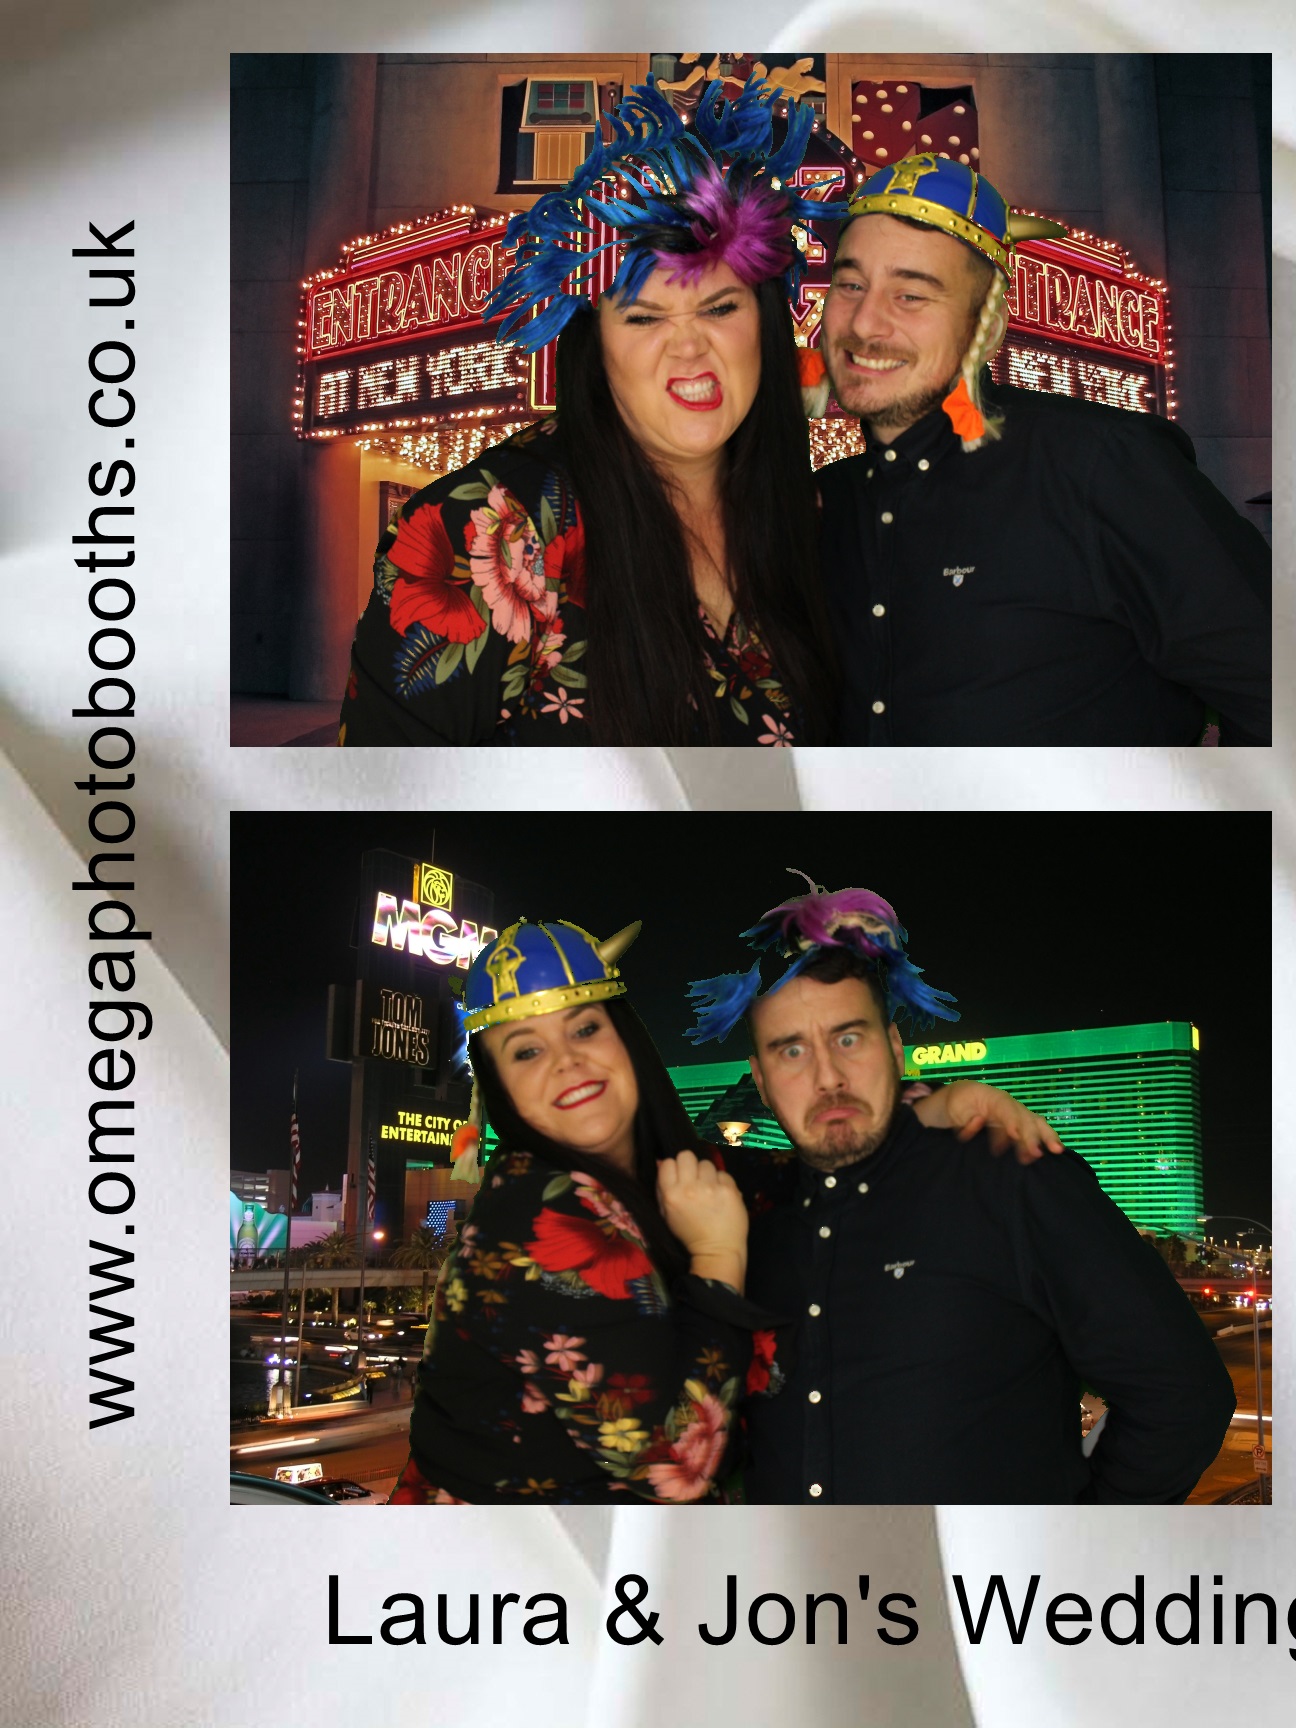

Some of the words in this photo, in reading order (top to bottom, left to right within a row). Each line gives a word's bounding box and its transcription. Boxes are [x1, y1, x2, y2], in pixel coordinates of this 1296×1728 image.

[312, 239, 522, 350] ENTRANCE
[1003, 252, 1160, 352] NTRANCE
[371, 891, 498, 970] MGM
[381, 989, 424, 1027] TOM
[371, 1025, 430, 1066] JONES
[911, 1041, 987, 1066] GRAND
[381, 1125, 453, 1146] ENTERTAIN
[398, 1111, 422, 1127] THE
[425, 1115, 451, 1131] CITY
